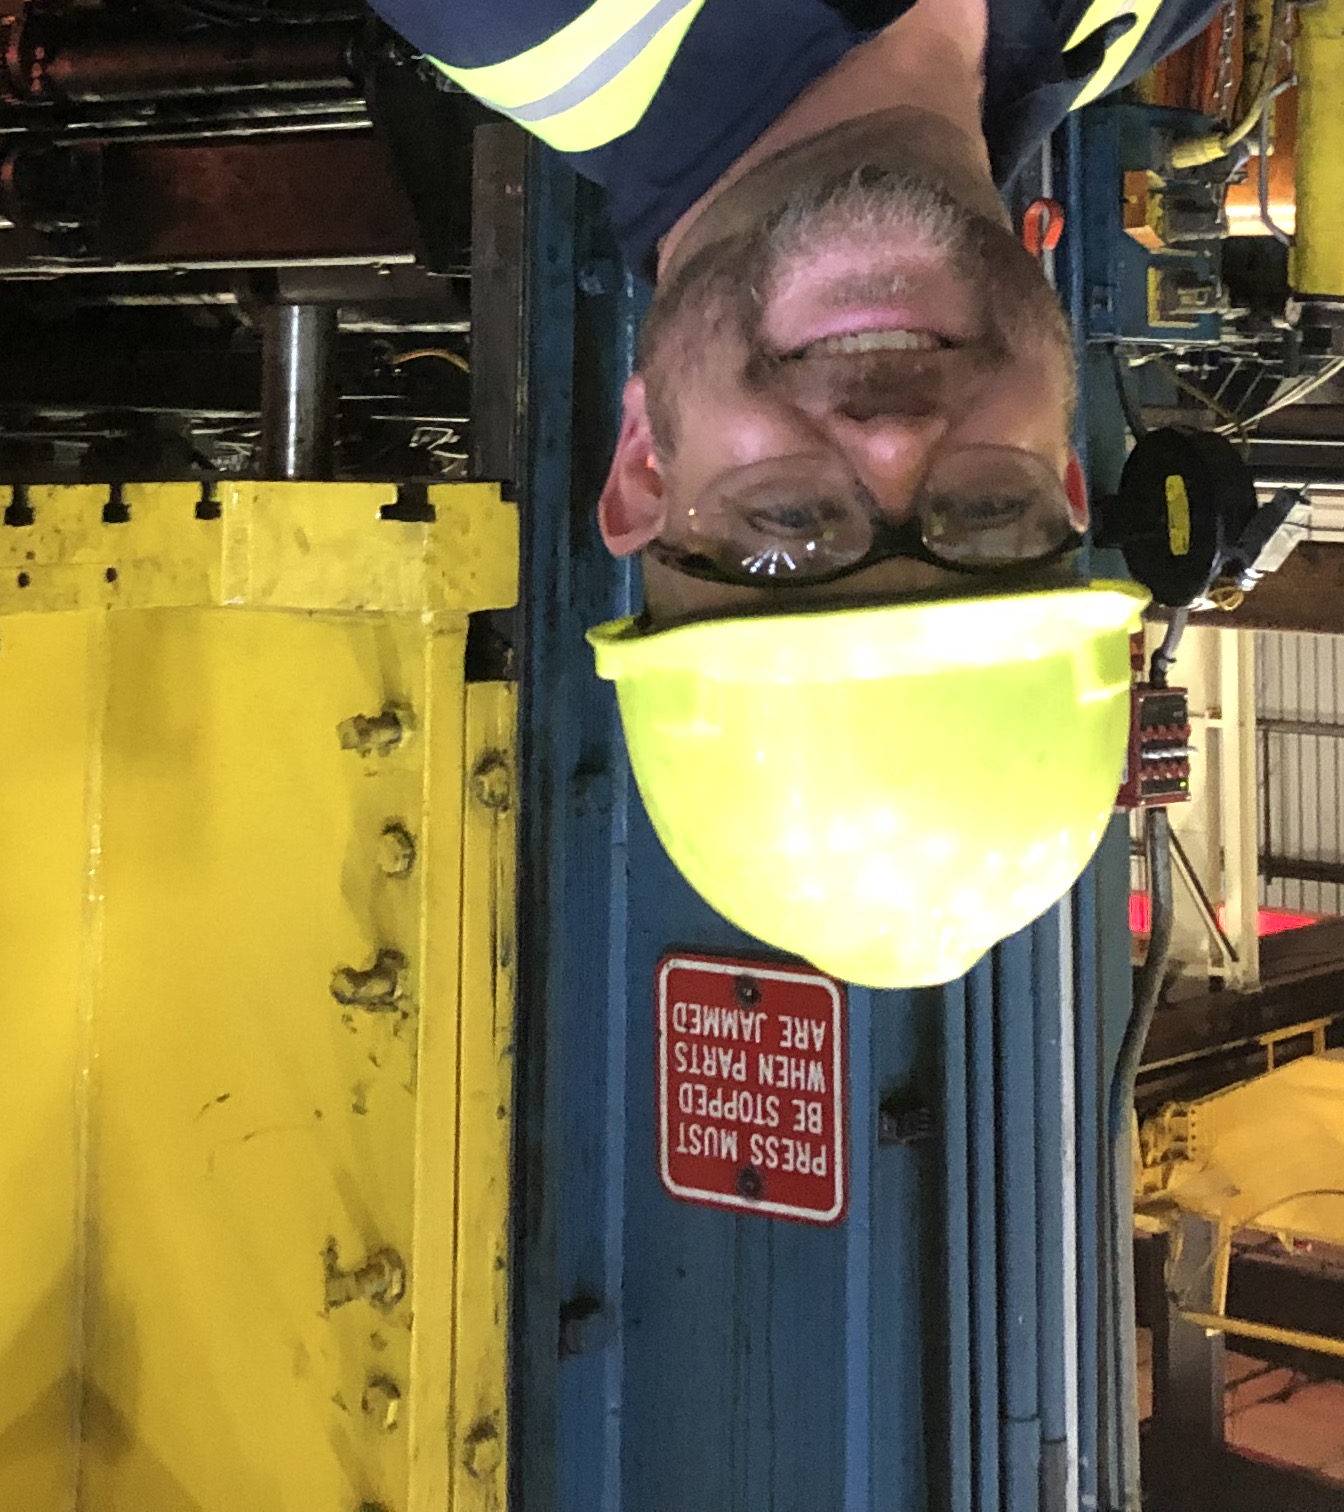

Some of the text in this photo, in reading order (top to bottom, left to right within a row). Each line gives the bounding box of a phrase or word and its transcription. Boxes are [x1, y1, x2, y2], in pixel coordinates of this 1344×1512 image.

[672, 1001, 826, 1052] ARE JAMMED
[674, 1041, 826, 1094] WHEN PARTS
[678, 1081, 823, 1134] BE STOPPED
[676, 1122, 827, 1177] PRESS MUST
